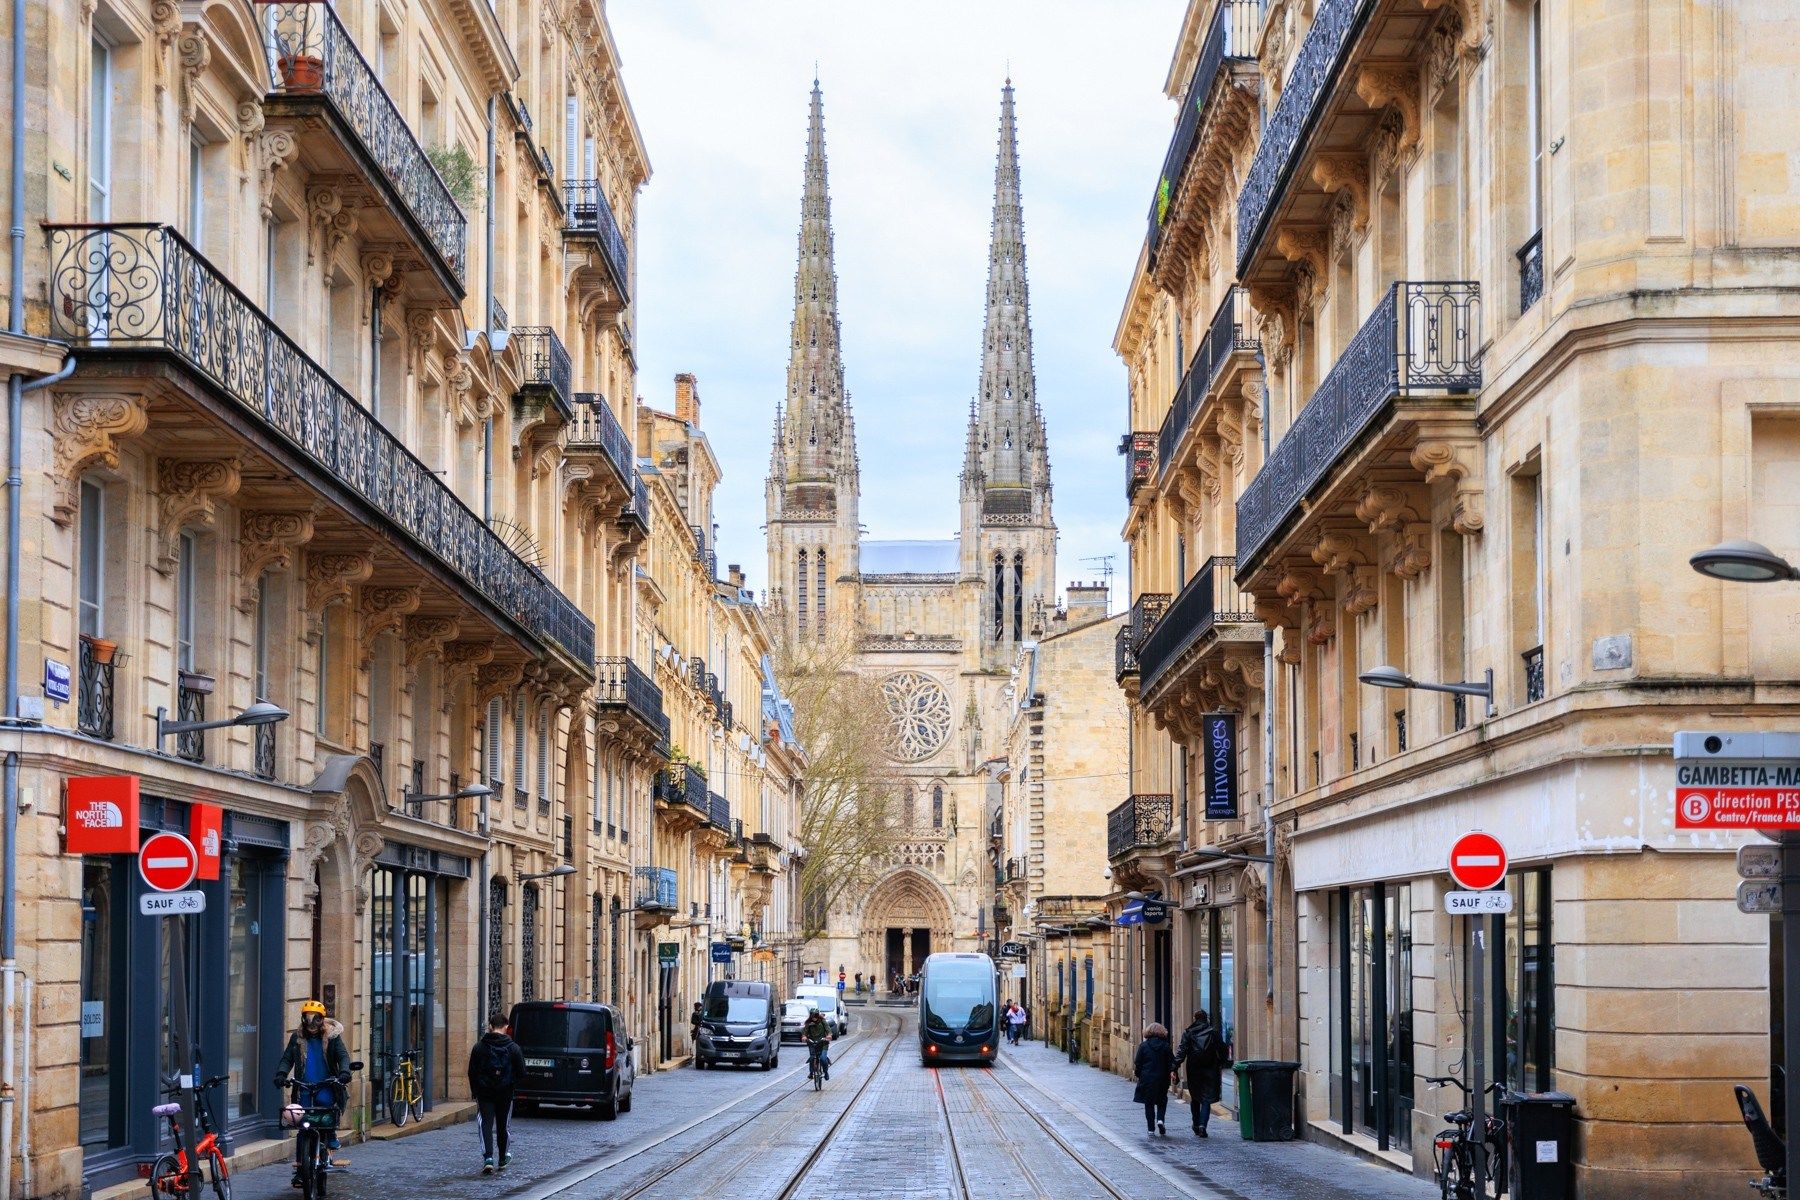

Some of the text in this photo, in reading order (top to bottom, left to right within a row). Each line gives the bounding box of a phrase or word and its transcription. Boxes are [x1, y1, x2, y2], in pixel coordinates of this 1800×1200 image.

[1210, 719, 1231, 806] linvosges
[1678, 766, 1800, 785] GAMBETTA-MA
[89, 801, 107, 810] THE
[1690, 791, 1799, 815] B direction PES
[76, 810, 107, 819] NORTH
[1715, 810, 1782, 825] Centre/France
[84, 819, 107, 828] FACE
[146, 898, 174, 910] SAUF
[1452, 898, 1481, 908] SAUF
[83, 1013, 102, 1025] SOLDES
